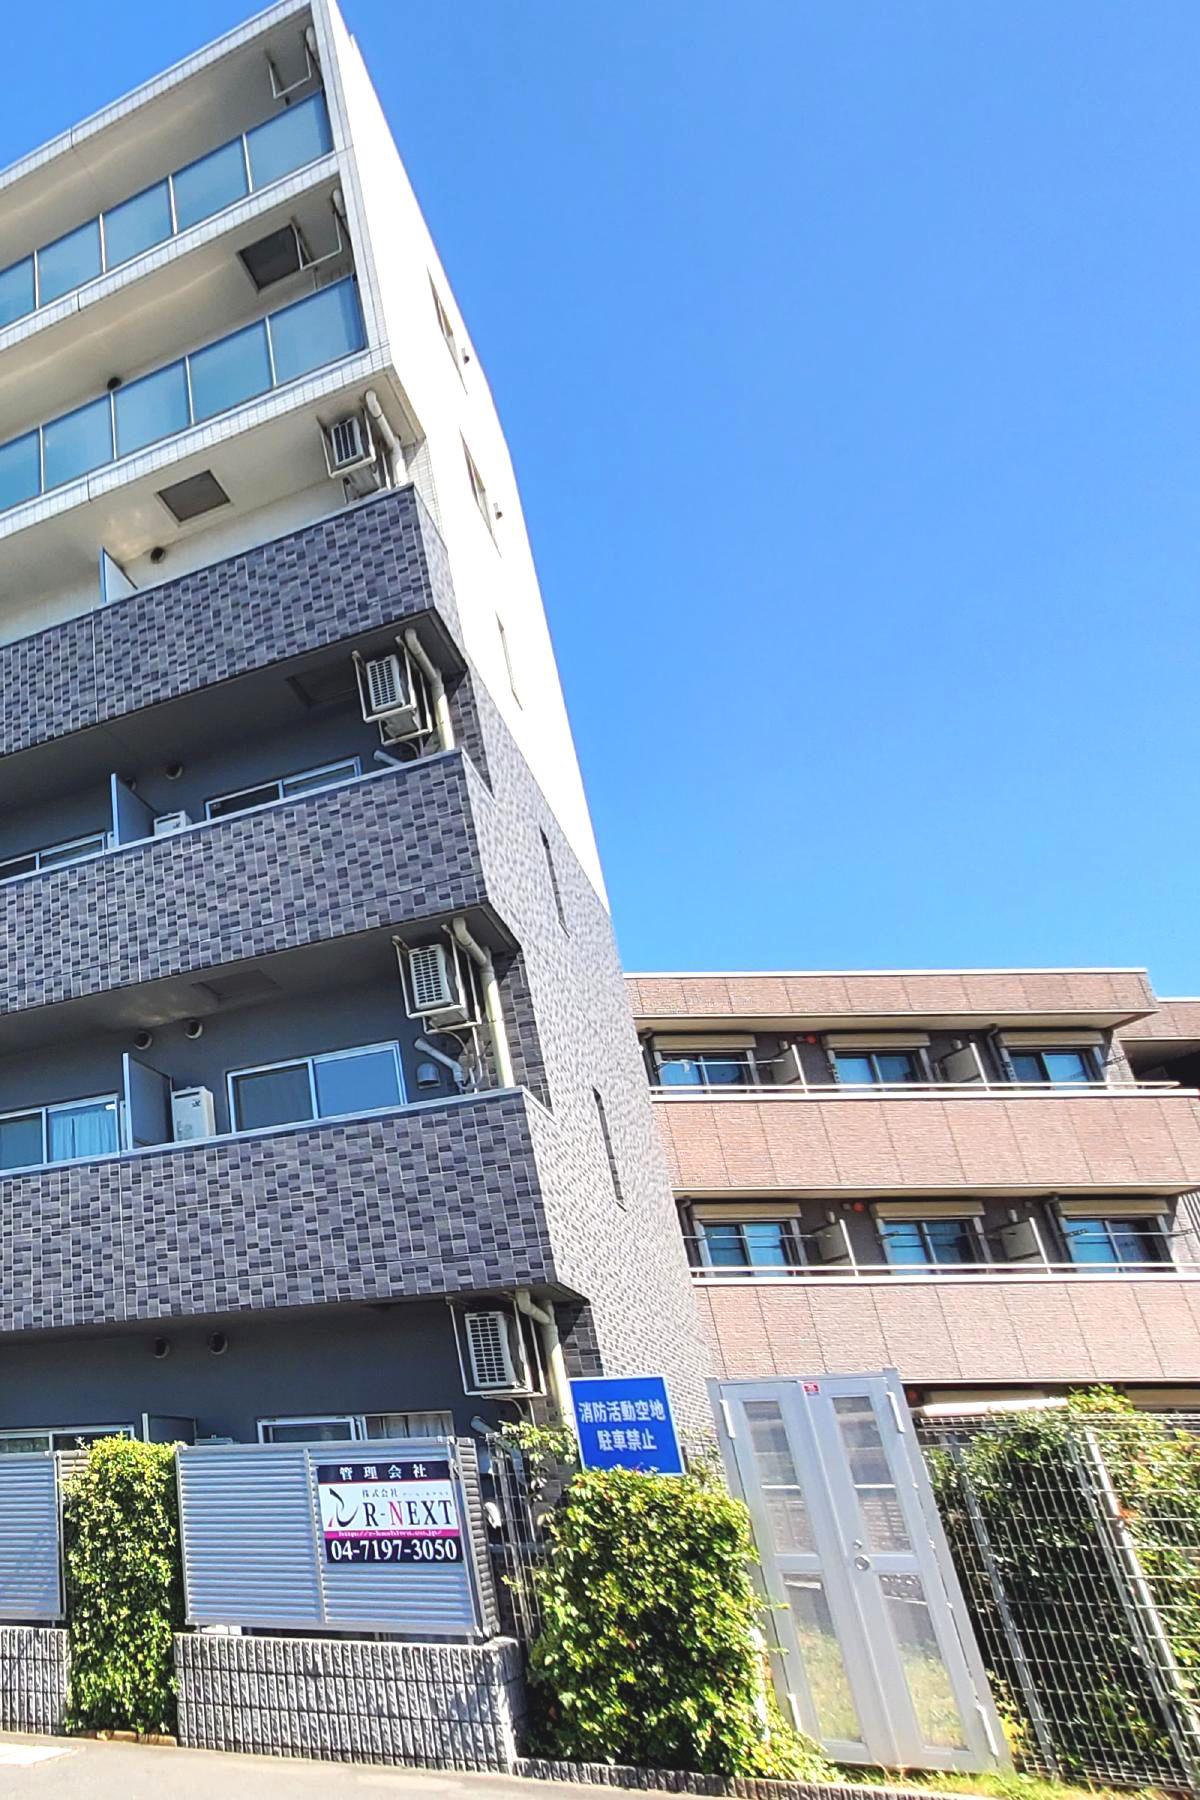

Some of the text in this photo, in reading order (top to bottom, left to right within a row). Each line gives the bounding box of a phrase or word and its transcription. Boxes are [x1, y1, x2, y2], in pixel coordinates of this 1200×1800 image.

[578, 1399, 666, 1423] 消防活動空地
[596, 1428, 657, 1451] 駐車禁止
[339, 1464, 427, 1481] 管理会社
[362, 1488, 399, 1498] 株式会社
[363, 1500, 452, 1526] R-NEXT
[331, 1539, 457, 1560] 04-7197-3050
